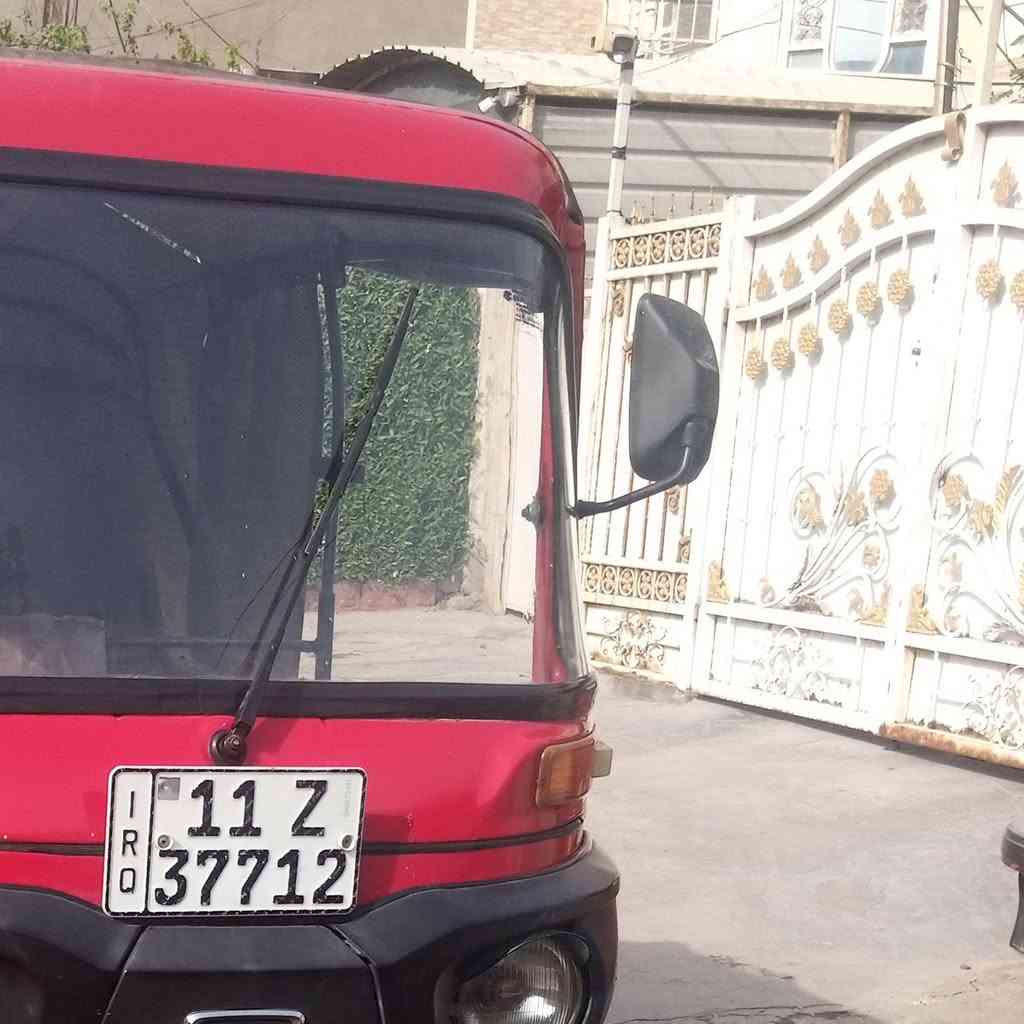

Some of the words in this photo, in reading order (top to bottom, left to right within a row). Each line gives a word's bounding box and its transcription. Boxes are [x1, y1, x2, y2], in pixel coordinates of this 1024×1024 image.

[187, 779, 262, 837] 11
[291, 780, 328, 837] Z
[154, 849, 347, 906] 37712
